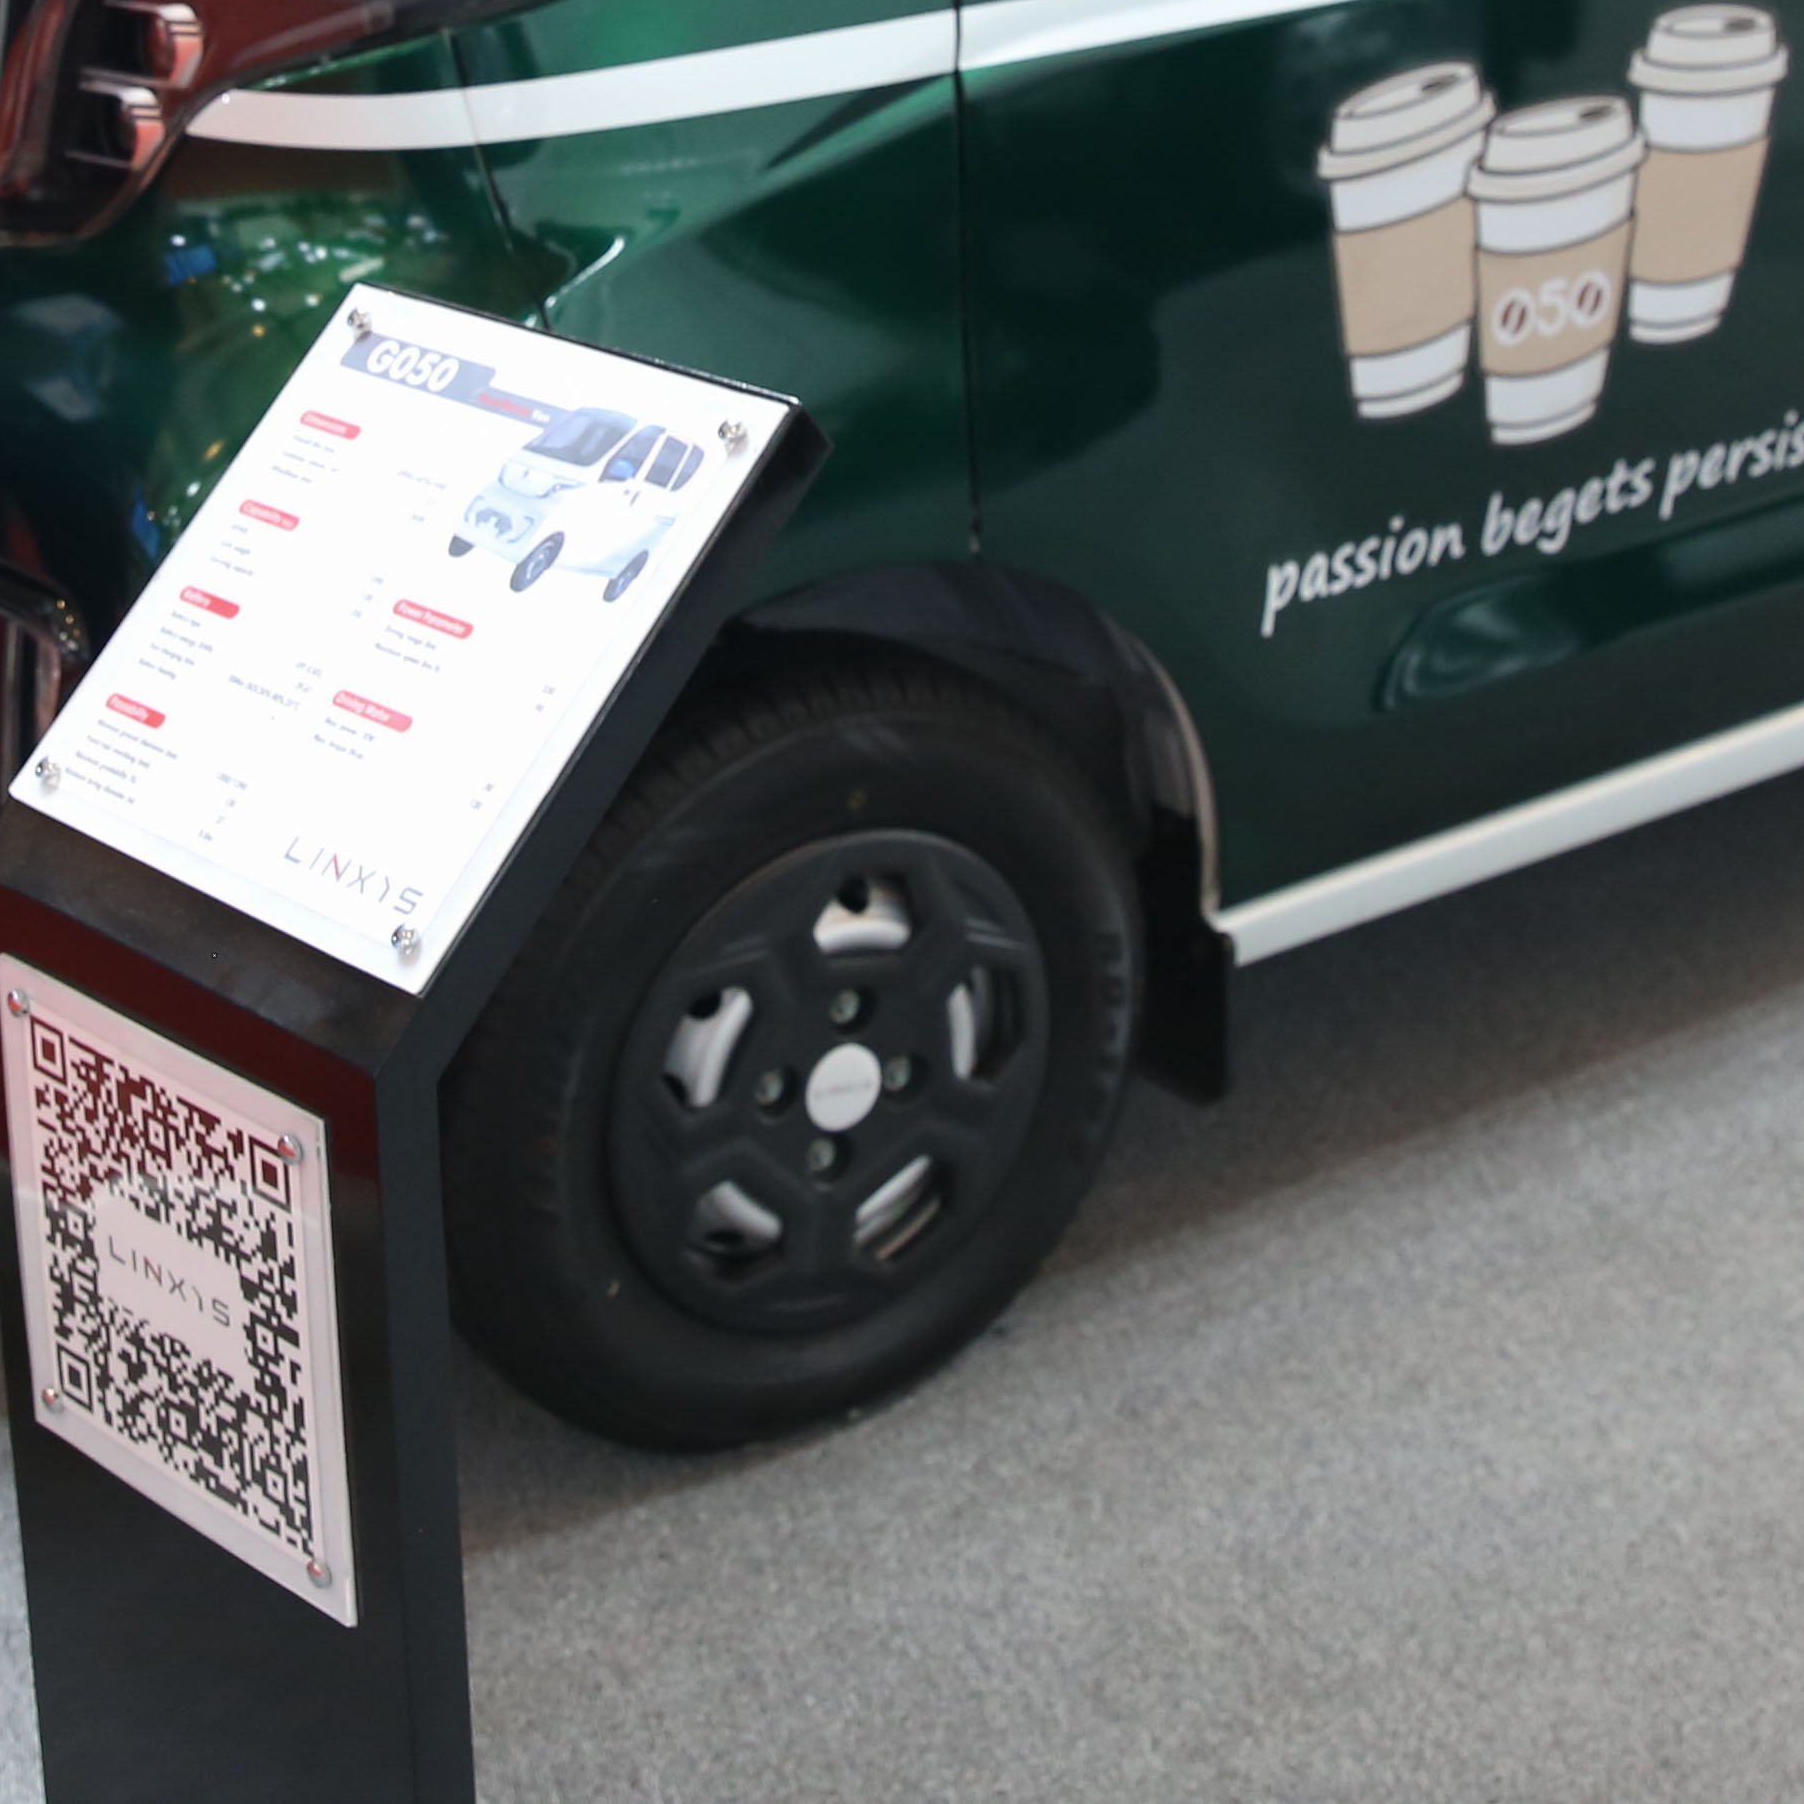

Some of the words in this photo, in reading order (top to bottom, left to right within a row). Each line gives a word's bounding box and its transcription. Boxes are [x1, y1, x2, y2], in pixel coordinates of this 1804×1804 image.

[1260, 517, 1467, 637] passion
[1481, 453, 1655, 555] begets
[284, 835, 424, 916] LINXYS
